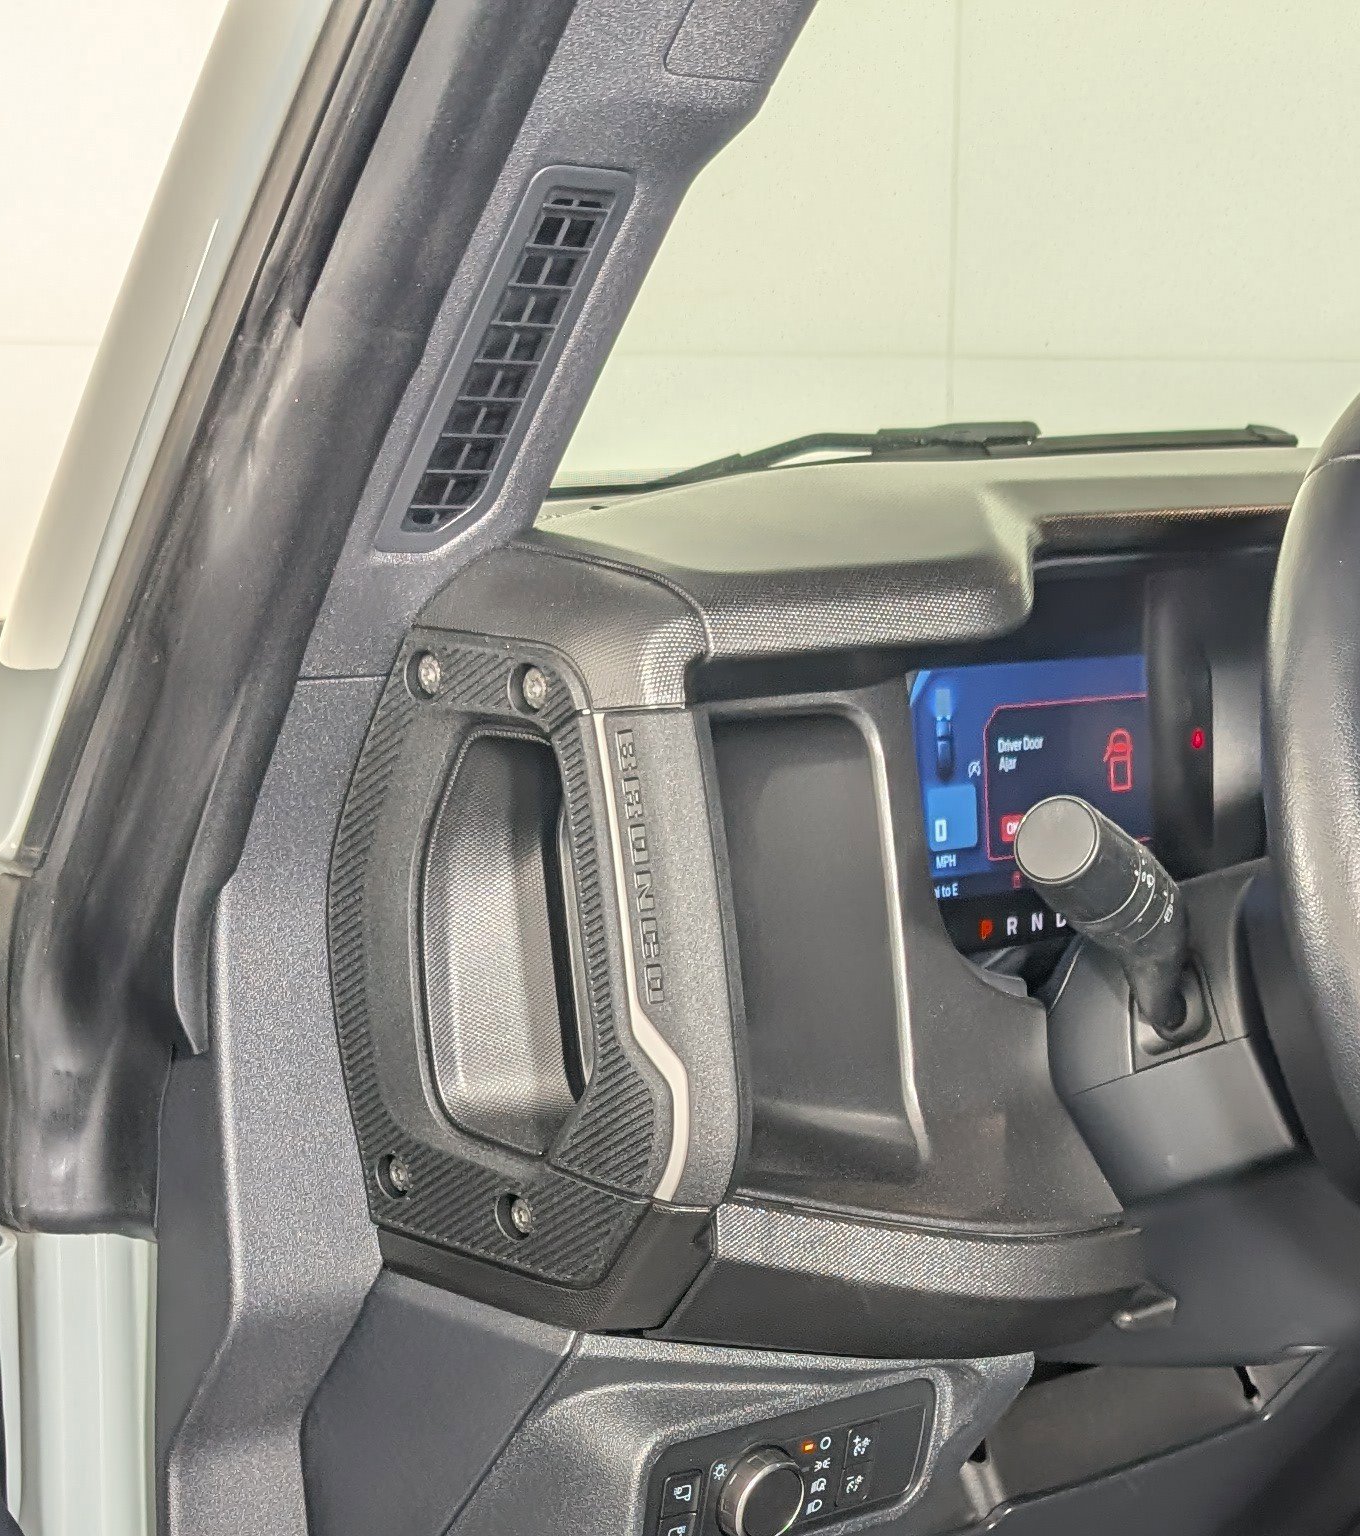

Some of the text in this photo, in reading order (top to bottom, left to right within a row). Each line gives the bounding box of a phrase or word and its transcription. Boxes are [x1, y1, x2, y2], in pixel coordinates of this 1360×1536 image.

[998, 736, 1043, 752] Driver Door
[999, 757, 1017, 772] Ajar
[935, 819, 947, 842] 0
[615, 728, 665, 1004] BRONCO
[936, 854, 956, 869] MPH
[941, 884, 952, 898] to
[952, 882, 959, 897] E
[981, 919, 993, 940] P
[1007, 916, 1018, 935] R
[1031, 913, 1043, 931] N
